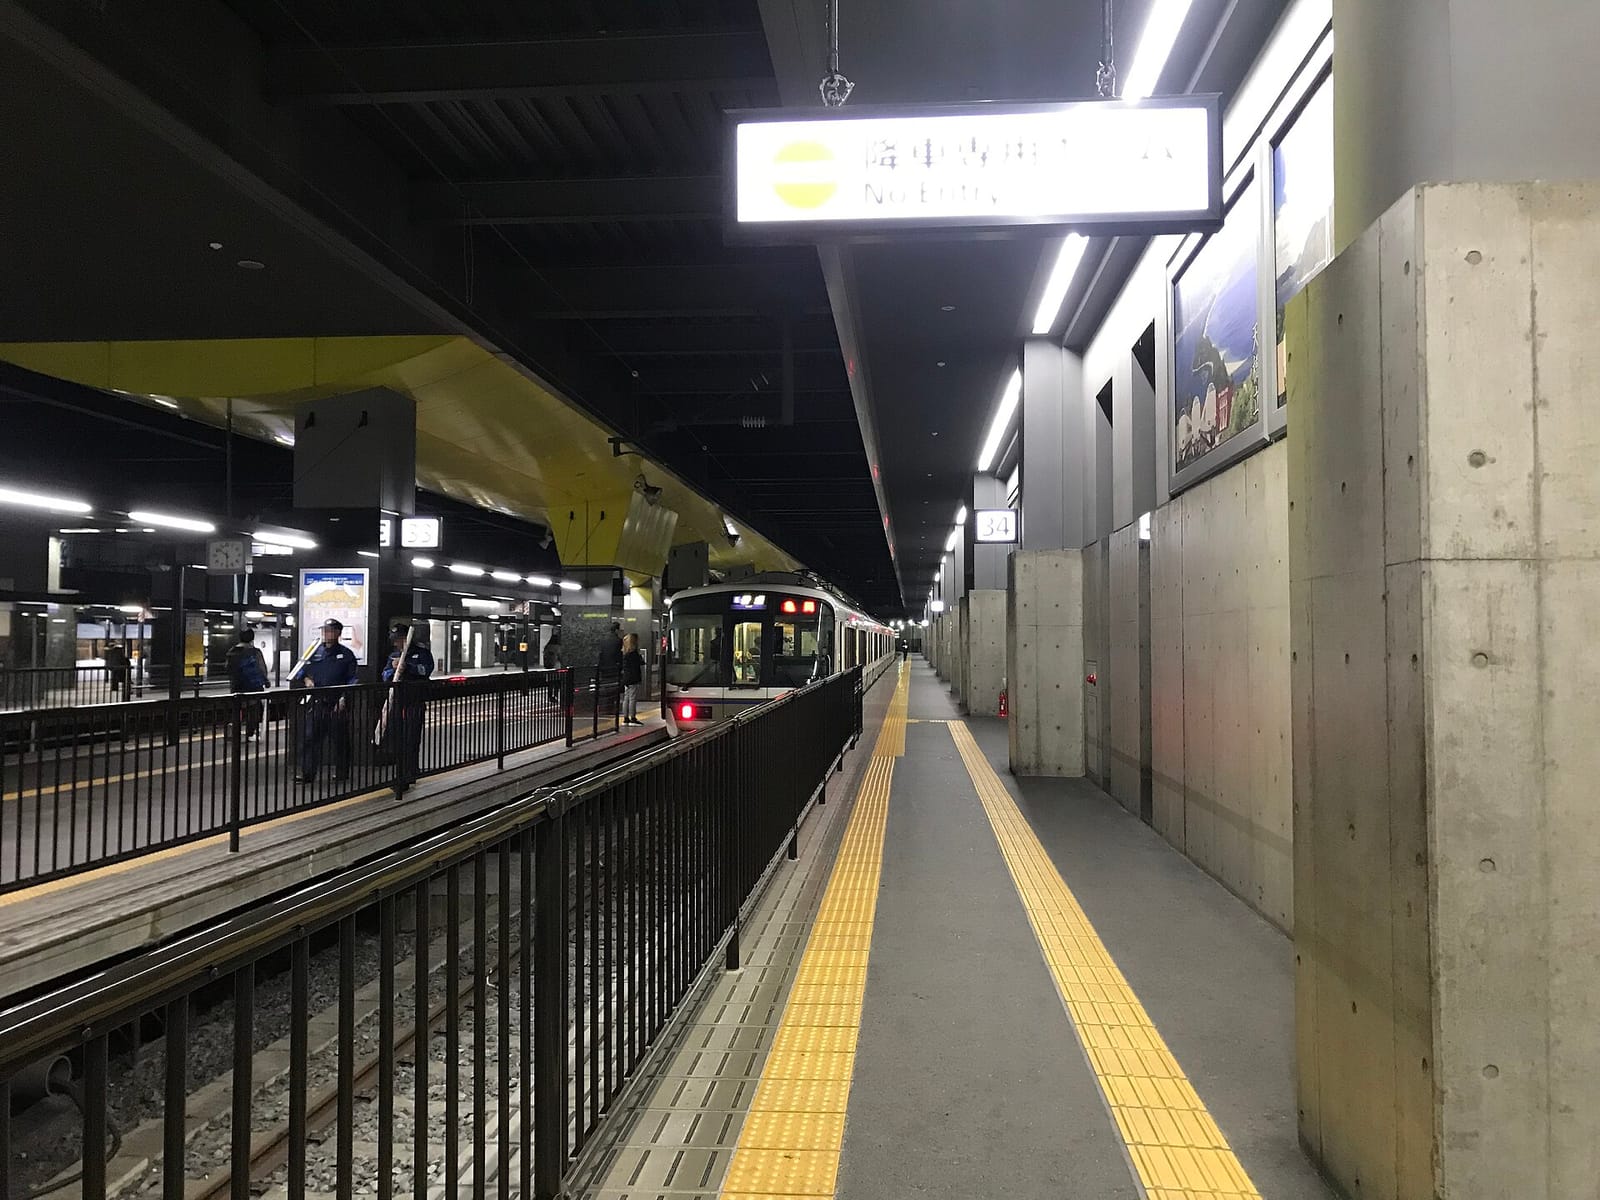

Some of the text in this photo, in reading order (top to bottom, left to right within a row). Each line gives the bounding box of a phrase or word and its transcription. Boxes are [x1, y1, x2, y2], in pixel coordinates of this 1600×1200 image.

[864, 134, 1176, 171] 降車専用ム
[864, 182, 907, 206] No
[982, 516, 1010, 537] 34
